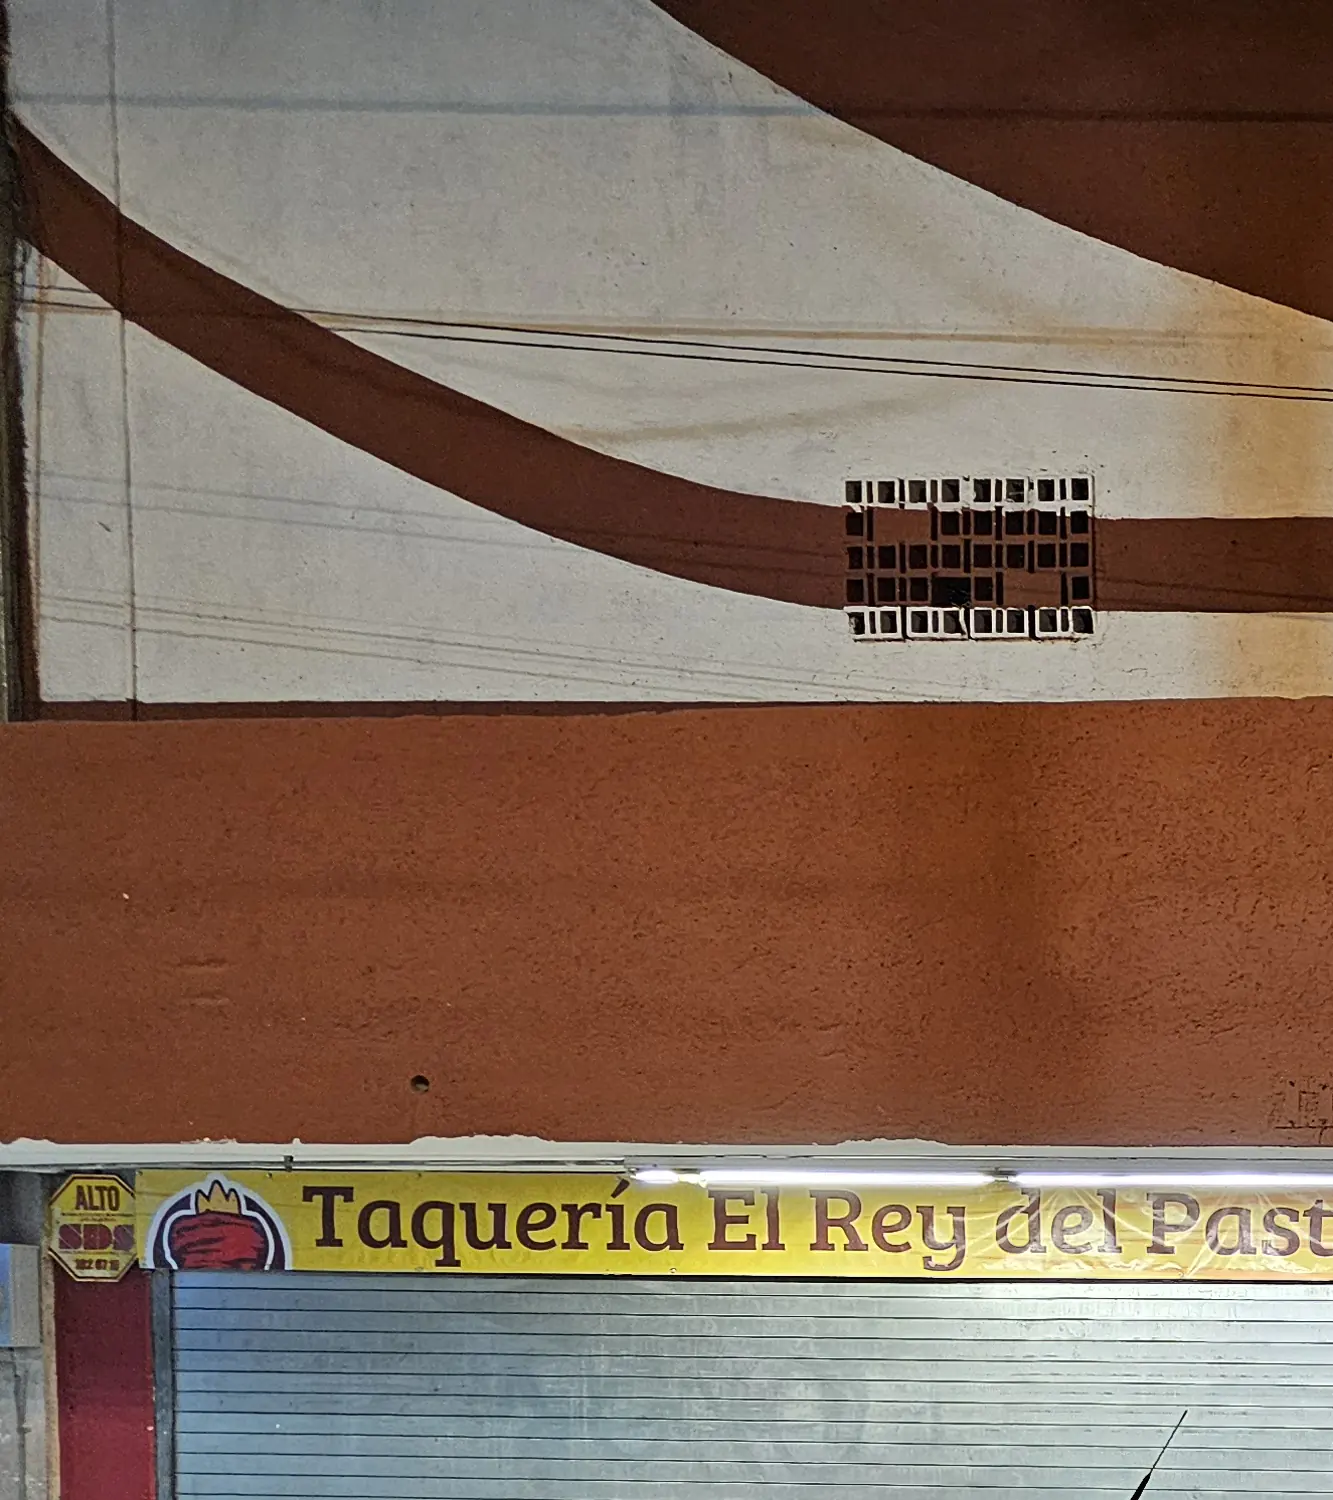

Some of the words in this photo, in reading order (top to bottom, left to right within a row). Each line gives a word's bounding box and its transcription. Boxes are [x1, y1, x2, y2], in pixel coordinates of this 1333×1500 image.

[75, 1185, 120, 1211] ALTO
[302, 1180, 684, 1268] Taquería
[707, 1187, 786, 1252] El
[809, 1189, 967, 1271] Rey
[995, 1188, 1124, 1255] del
